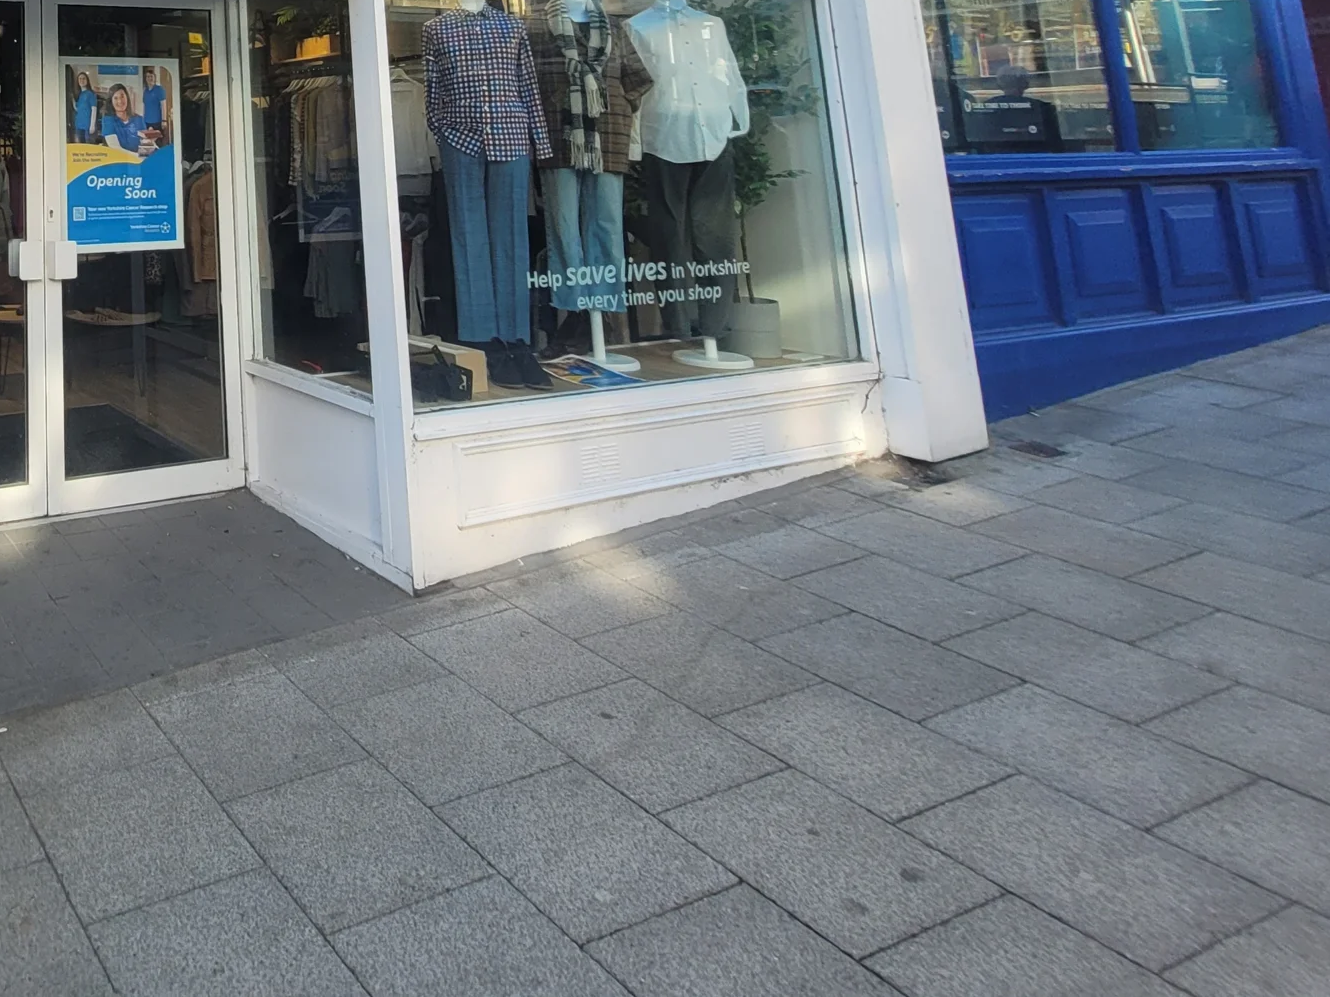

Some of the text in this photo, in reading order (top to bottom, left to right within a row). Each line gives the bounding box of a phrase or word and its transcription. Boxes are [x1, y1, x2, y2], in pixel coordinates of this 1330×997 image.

[86, 174, 142, 190] Opening
[124, 188, 157, 199] Soon
[526, 257, 751, 290] Help save lives in Yorkshire
[577, 284, 722, 311] every time you shop
